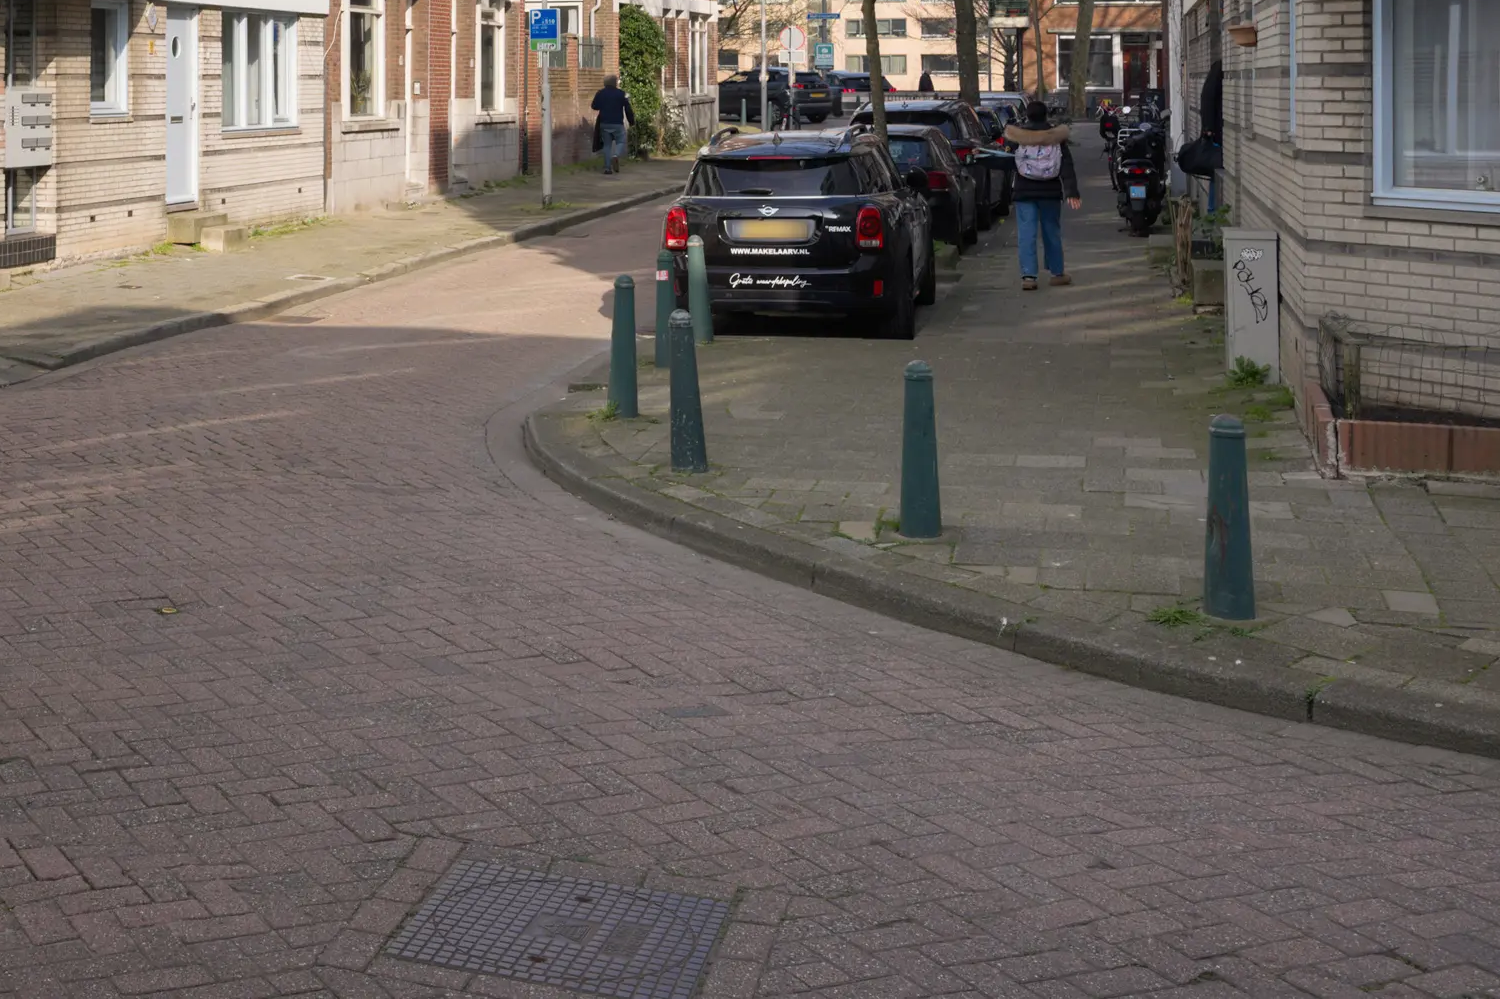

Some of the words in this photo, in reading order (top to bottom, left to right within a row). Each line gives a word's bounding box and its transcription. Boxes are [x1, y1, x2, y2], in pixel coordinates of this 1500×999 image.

[531, 10, 542, 25] P
[730, 247, 810, 255] WWW.MAKELAARV.NL
[729, 272, 754, 288] Gratis
